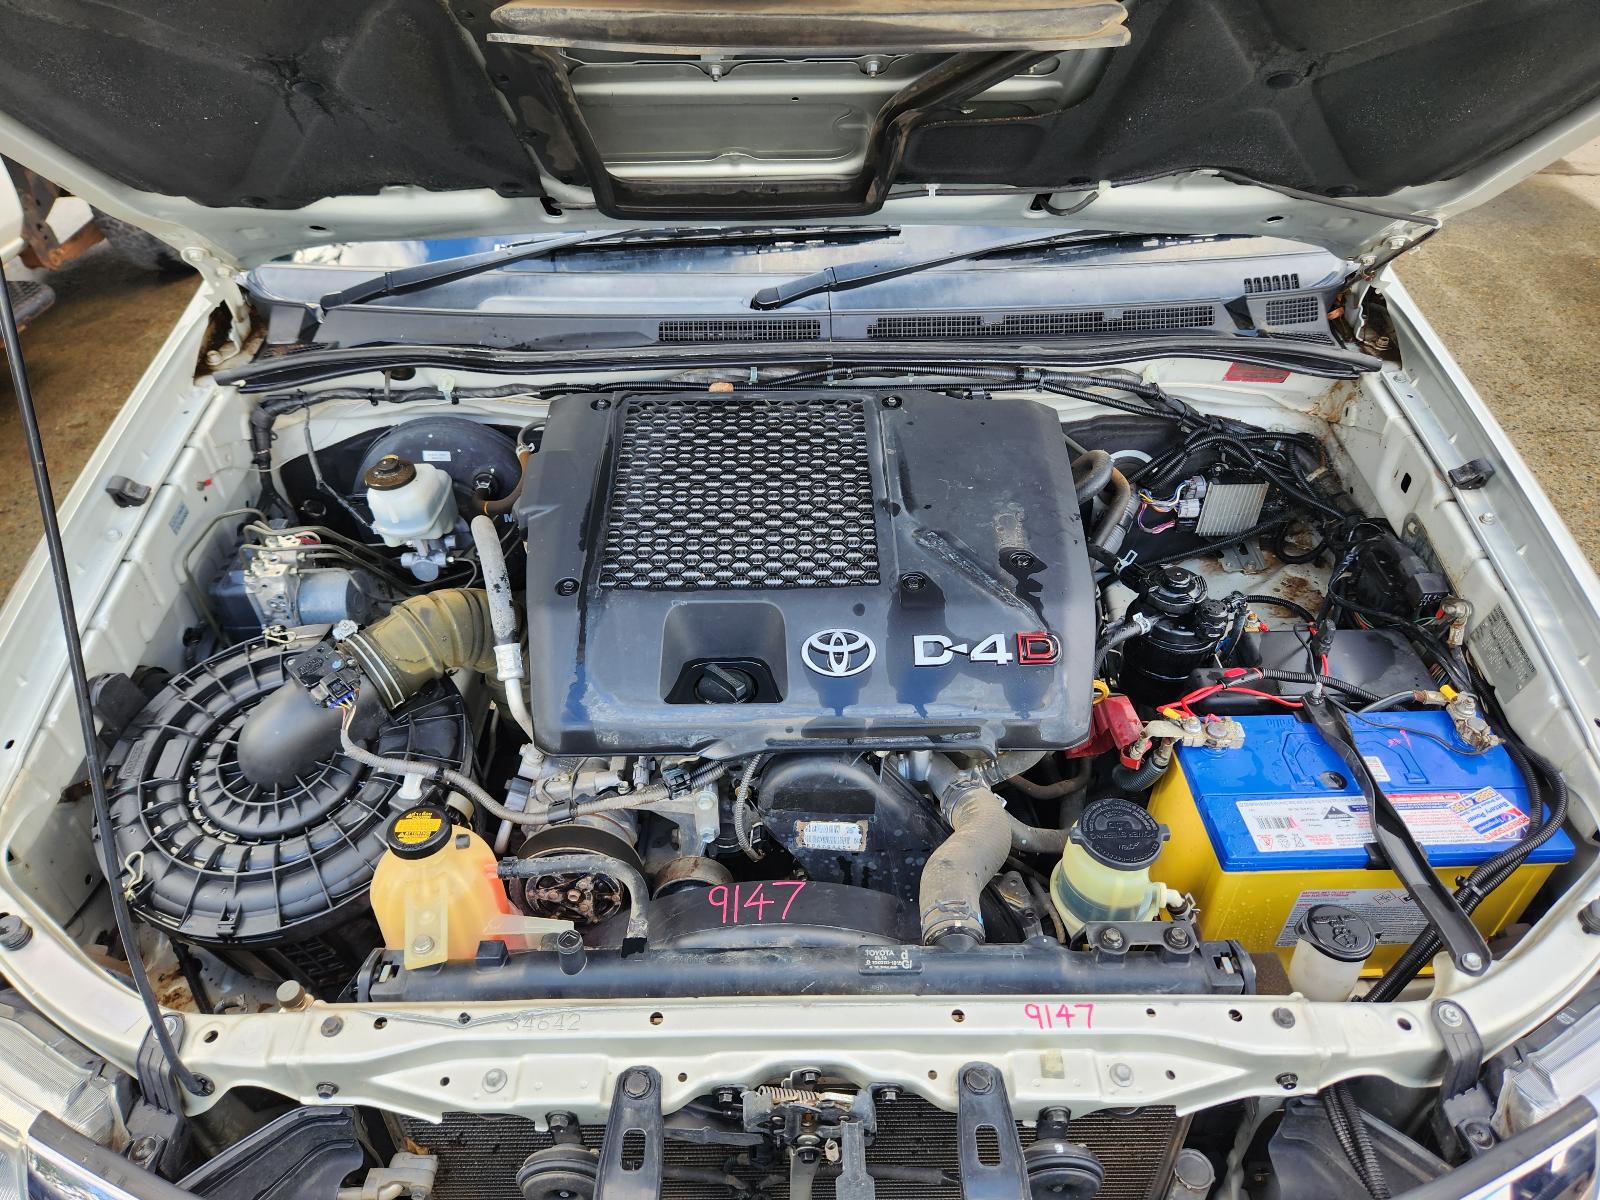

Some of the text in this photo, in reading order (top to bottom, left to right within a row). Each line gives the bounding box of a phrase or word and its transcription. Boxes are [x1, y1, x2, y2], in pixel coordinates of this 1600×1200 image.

[708, 879, 807, 924] 9147
[864, 948, 894, 956] TOYOTA
[1024, 1003, 1095, 1029] 9147
